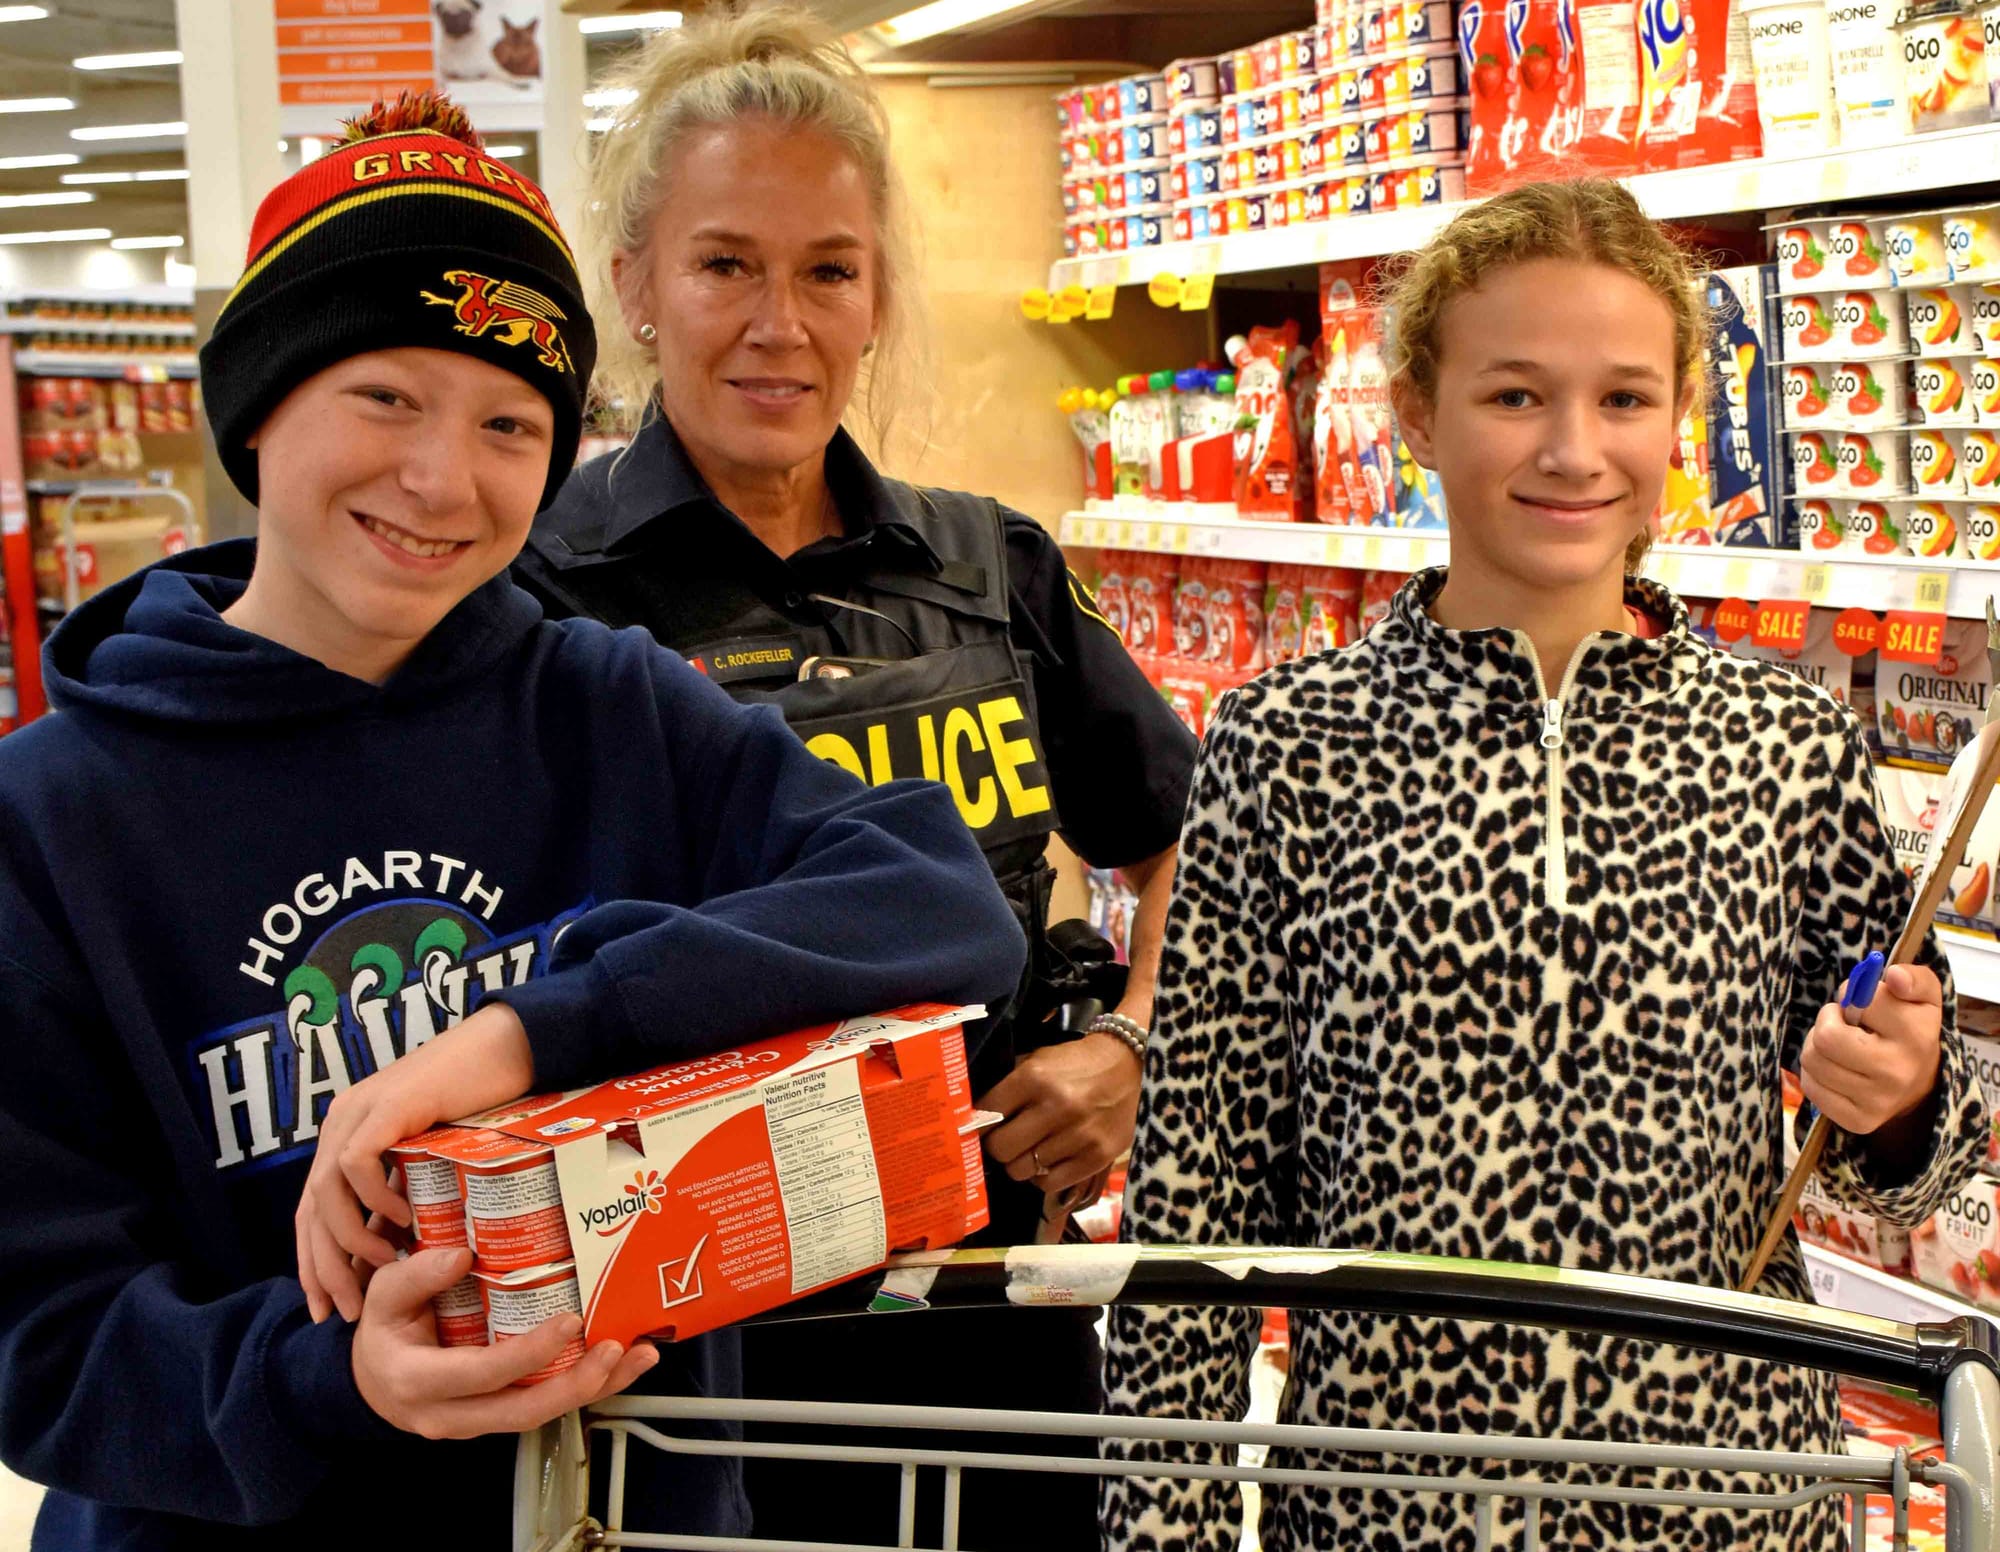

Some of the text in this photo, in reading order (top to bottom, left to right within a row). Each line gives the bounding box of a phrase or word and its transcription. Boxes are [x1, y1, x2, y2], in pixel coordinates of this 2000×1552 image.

[1718, 343, 1754, 473] TUBES
[1920, 583, 1942, 602] 1.00
[1717, 611, 1749, 630] SALE
[1757, 609, 1804, 640] SALE
[1835, 623, 1876, 642] SALE
[1886, 622, 1940, 654] SALE
[714, 648, 794, 669] C. ROCKEFELLER
[1898, 672, 1986, 712] ORIGINAL
[239, 850, 505, 987] HOGARTH
[613, 1051, 743, 1091] Creamy
[764, 1081, 790, 1096] Valeur
[792, 1070, 827, 1087] nutritive
[765, 1089, 802, 1107] Nutrition
[803, 1081, 827, 1095] Facts
[677, 1186, 693, 1196] SANS
[692, 1191, 703, 1200] NO
[703, 1181, 733, 1196] ARTIFICIAL
[698, 1202, 711, 1212] FAIT
[711, 1197, 727, 1208] AVEC
[736, 1188, 753, 1199] VRAIS
[753, 1181, 773, 1194] FRUITS
[710, 1205, 727, 1217] MADE
[728, 1200, 743, 1210] WITH
[758, 1189, 775, 1200] FRUIT
[717, 1220, 748, 1236] PREPARED
[721, 1235, 746, 1248] SOURCE
[755, 1223, 783, 1237] CALCIUM
[1946, 1217, 1986, 1243] FRUIT
[722, 1243, 747, 1256] SOURCE
[756, 1230, 784, 1245] CALCIUM
[718, 1258, 743, 1271] SOURCE
[751, 1246, 779, 1260] VITAMINE
[722, 1264, 747, 1277] SOURCE
[756, 1253, 781, 1266] VITAMIN
